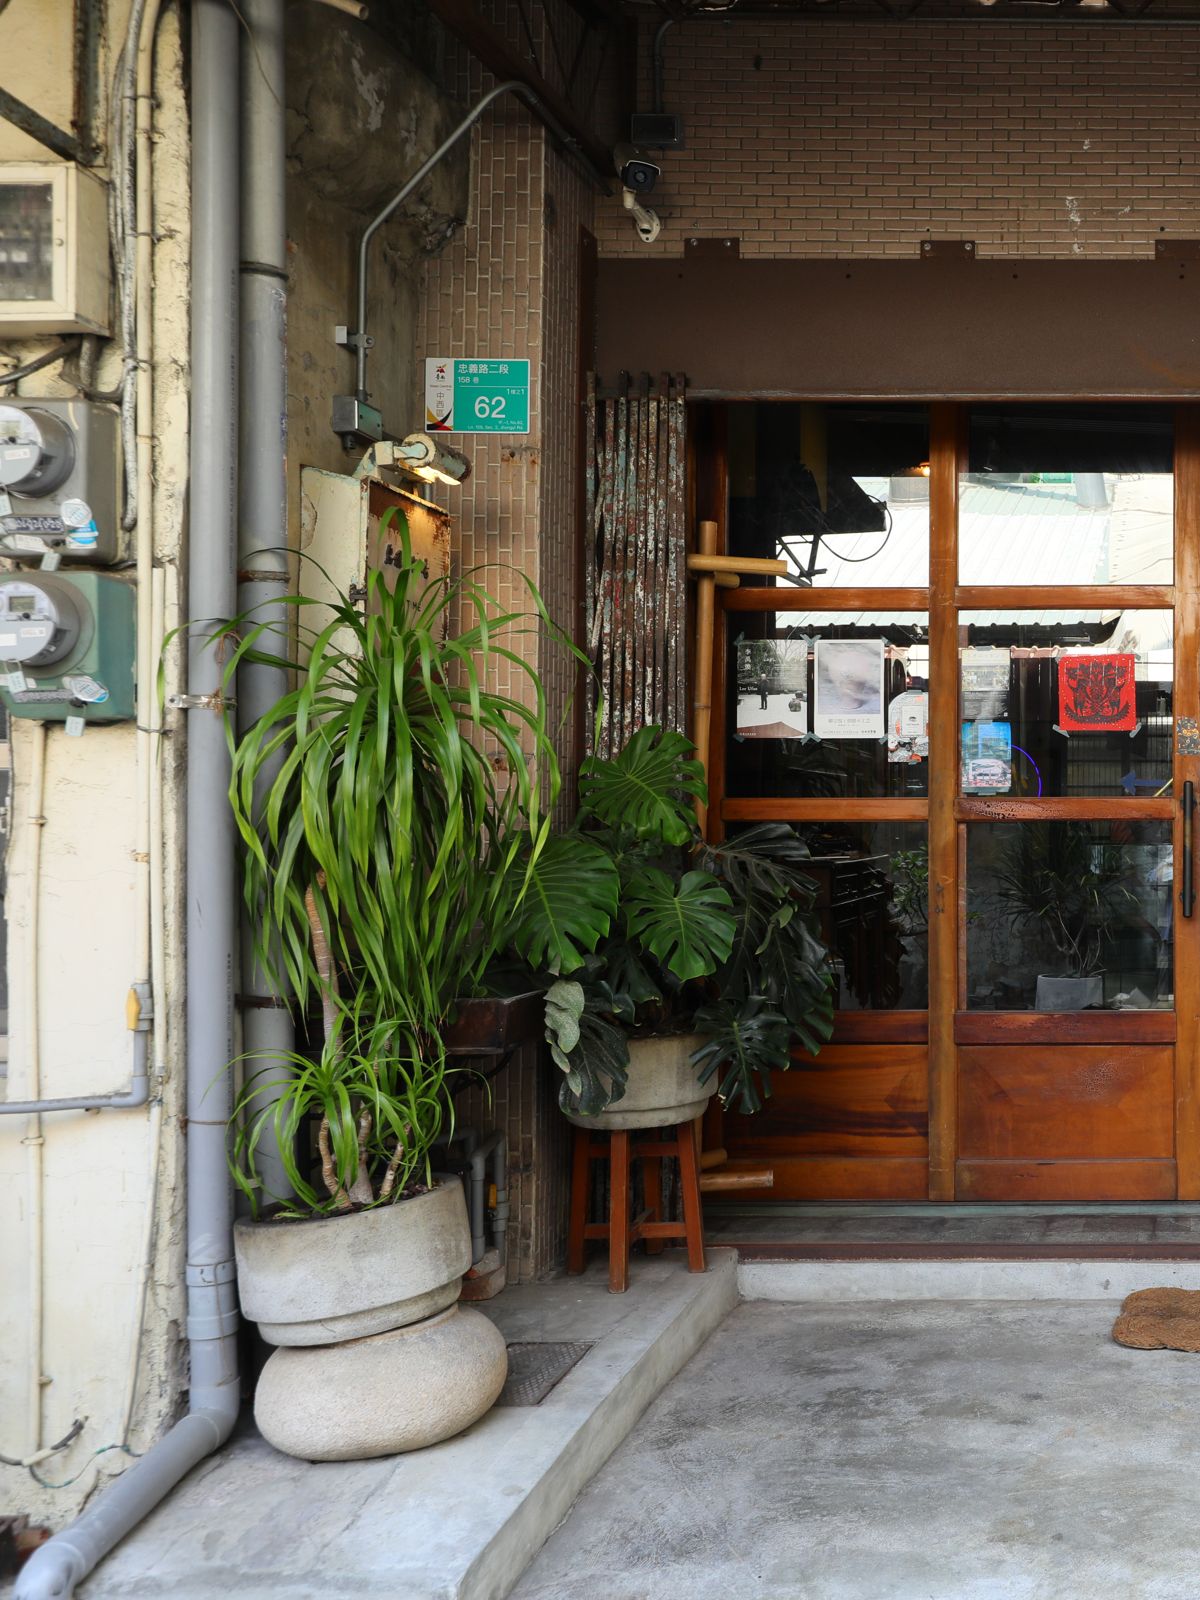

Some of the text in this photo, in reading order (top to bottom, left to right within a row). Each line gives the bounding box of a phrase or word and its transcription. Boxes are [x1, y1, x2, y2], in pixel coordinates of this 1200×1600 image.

[458, 364, 509, 374] 忠義路二段
[474, 396, 506, 418] 62
